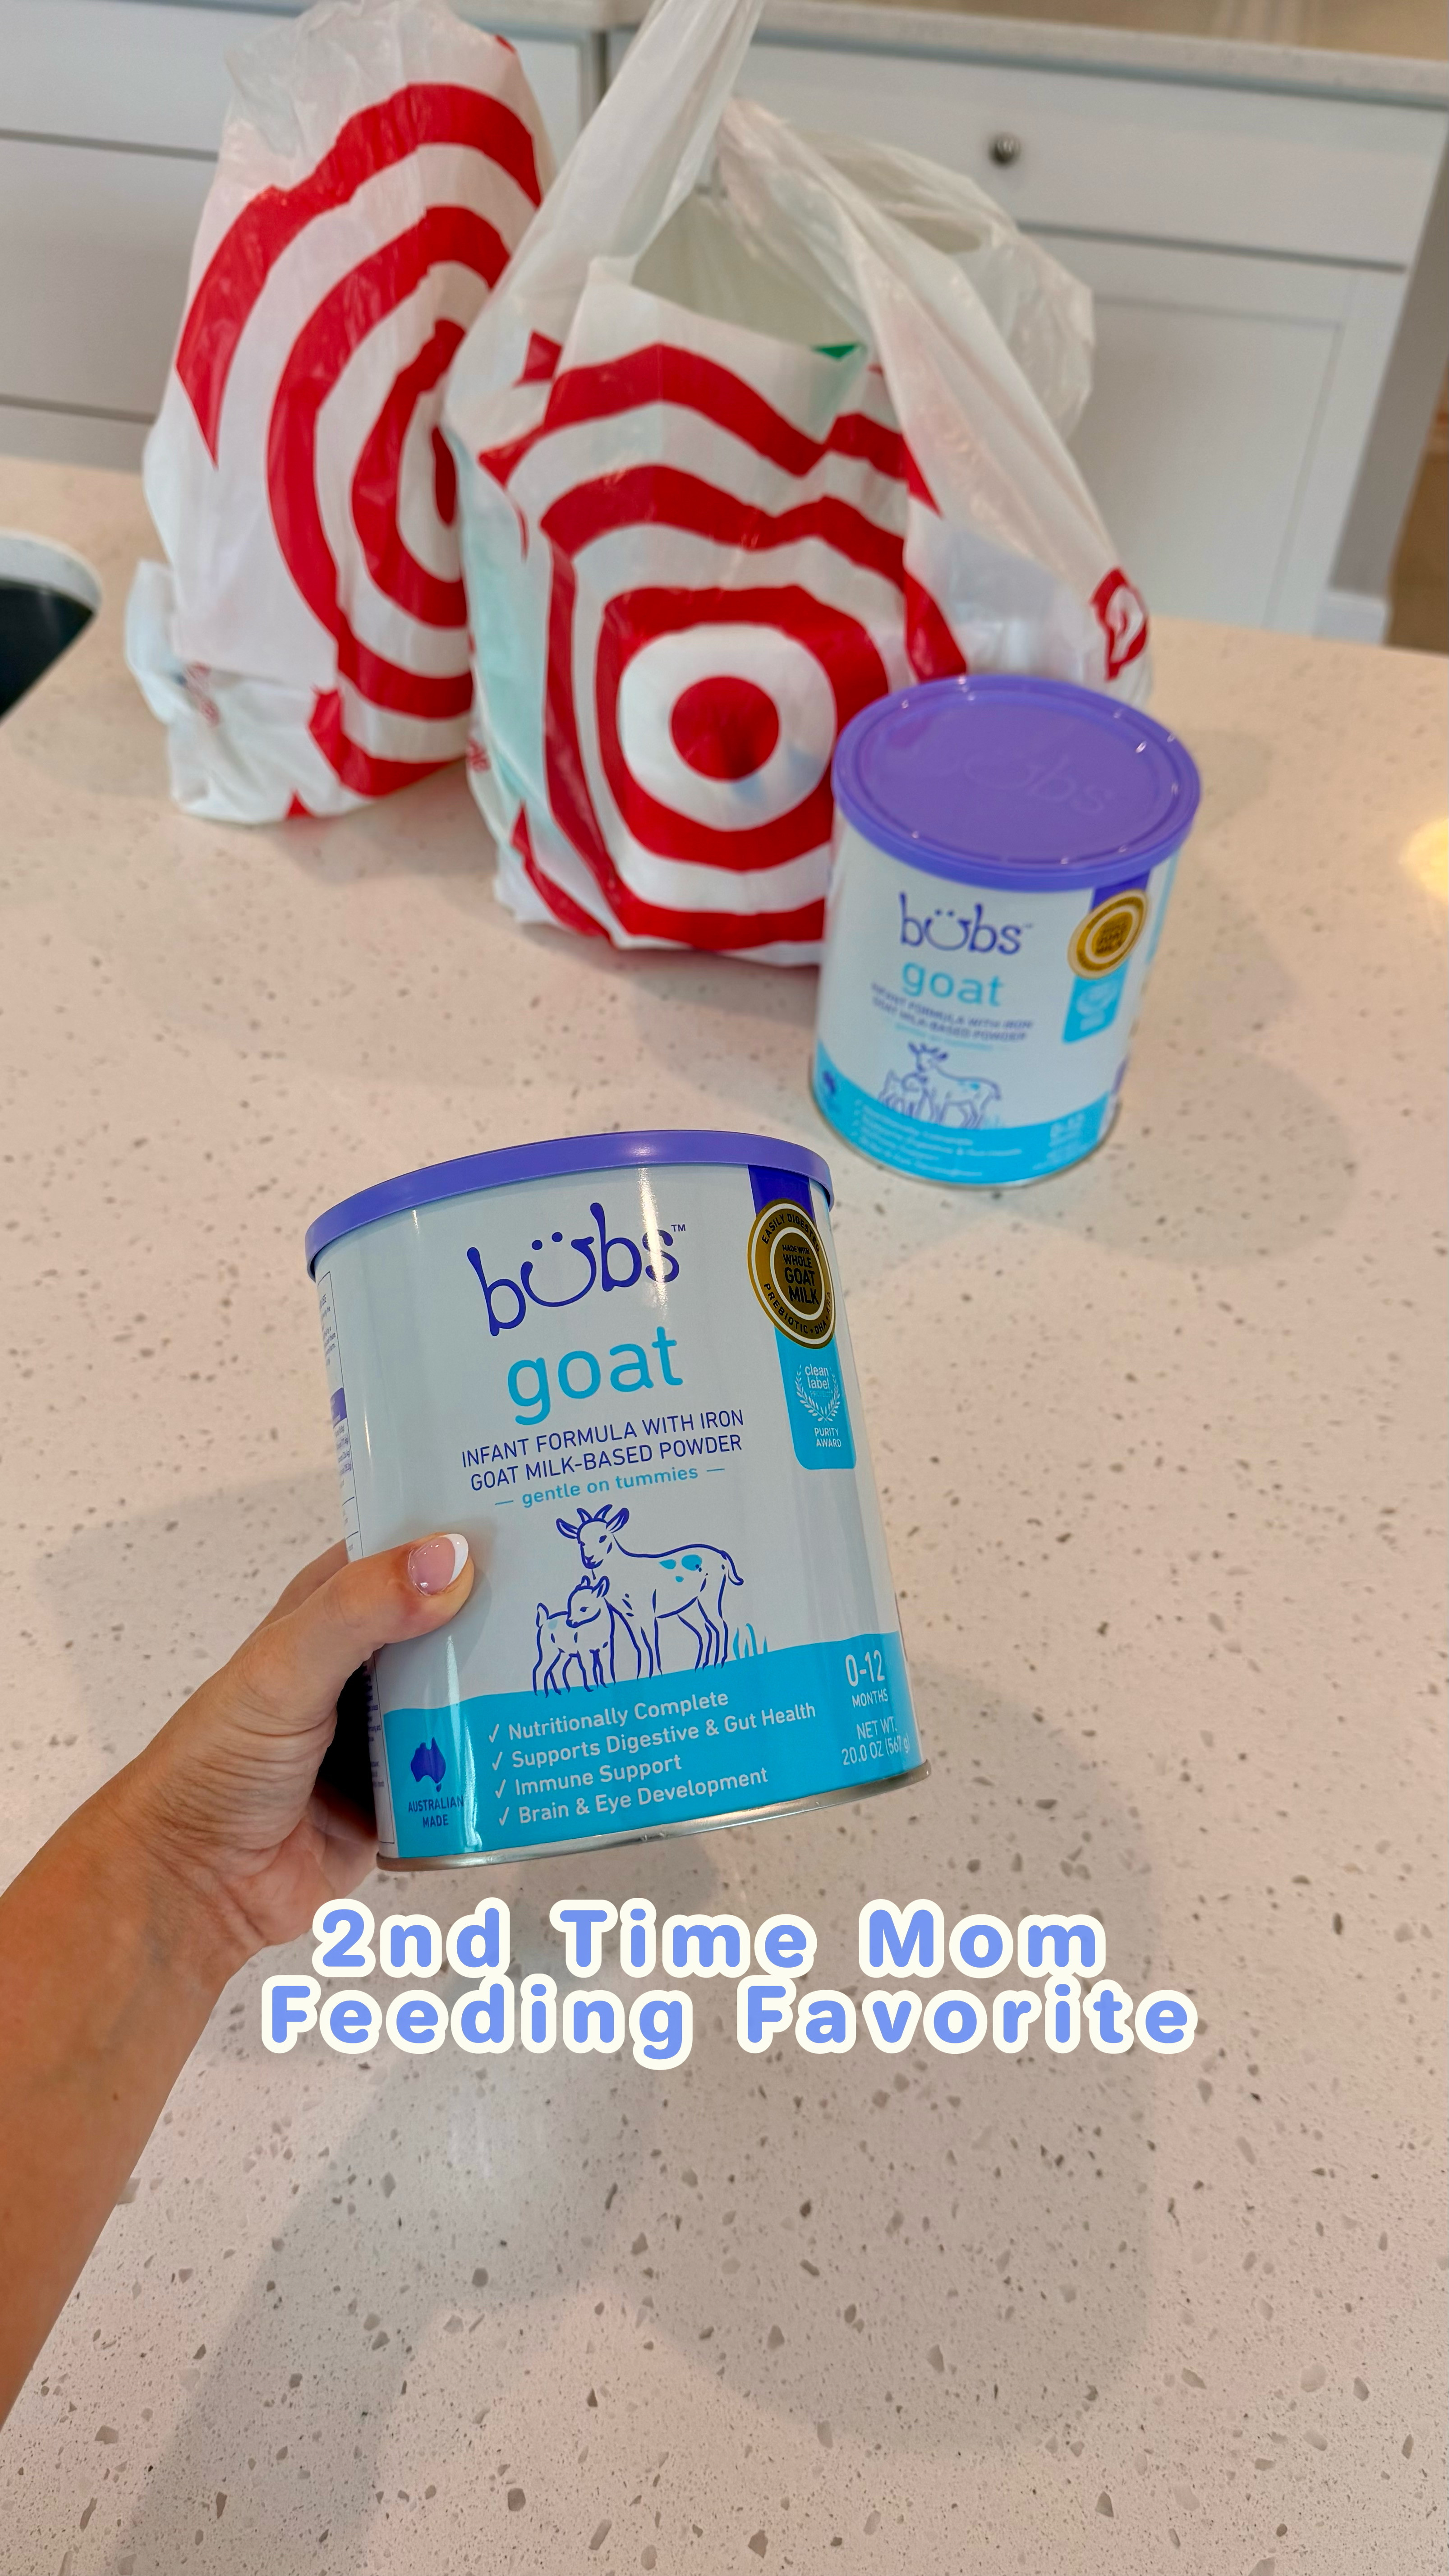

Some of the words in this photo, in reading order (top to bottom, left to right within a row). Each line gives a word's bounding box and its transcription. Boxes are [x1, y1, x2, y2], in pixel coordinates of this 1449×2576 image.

[902, 962, 1003, 1007] goat
[761, 1213, 785, 1245] EASILY
[786, 1213, 820, 1252] DIGESTED
[782, 1244, 797, 1253] MADE
[797, 1246, 810, 1255] WITH
[782, 1253, 813, 1269] WHOLE
[784, 1266, 815, 1287] GOAT
[763, 1282, 809, 1334] PREBIOTIC
[814, 1319, 827, 1335] DHA
[788, 1285, 820, 1306] MILK
[507, 1326, 683, 1426] goat
[804, 1363, 829, 1377] clean
[807, 1377, 830, 1389] label
[462, 1438, 529, 1468] INFANT
[536, 1421, 637, 1453] FORMULA
[642, 1413, 694, 1436] WITH
[700, 1409, 744, 1429] IRON
[814, 1427, 839, 1437] PURITY
[816, 1438, 842, 1448] AWARD
[470, 1465, 519, 1491] GOAT
[525, 1444, 653, 1481] MILK-BASED
[659, 1434, 742, 1459] POWDER
[521, 1482, 581, 1509] gentle
[586, 1479, 610, 1494] on
[615, 1466, 699, 1489] tummies
[845, 1649, 885, 1687] 0-12
[851, 1688, 888, 1708] MONTHS
[508, 1707, 628, 1741] Nutritionally
[634, 1692, 729, 1717] Complete
[856, 1720, 878, 1740] NET
[879, 1716, 898, 1734] WT.
[512, 1741, 601, 1768] Supports
[606, 1725, 699, 1754] Digestive
[705, 1718, 720, 1737] &
[723, 1713, 758, 1733] Gut
[761, 1702, 816, 1726] Health
[841, 1744, 868, 1766] 20.0
[869, 1740, 884, 1759] OZ
[515, 1771, 594, 1796] Immune
[599, 1754, 682, 1782] Support
[408, 1794, 464, 1813] AUSTRALIAN
[518, 1802, 569, 1824] Brain
[576, 1797, 590, 1816] &
[595, 1794, 632, 1814] Eye
[637, 1767, 768, 1805] Development
[422, 1814, 449, 1828] MADE
